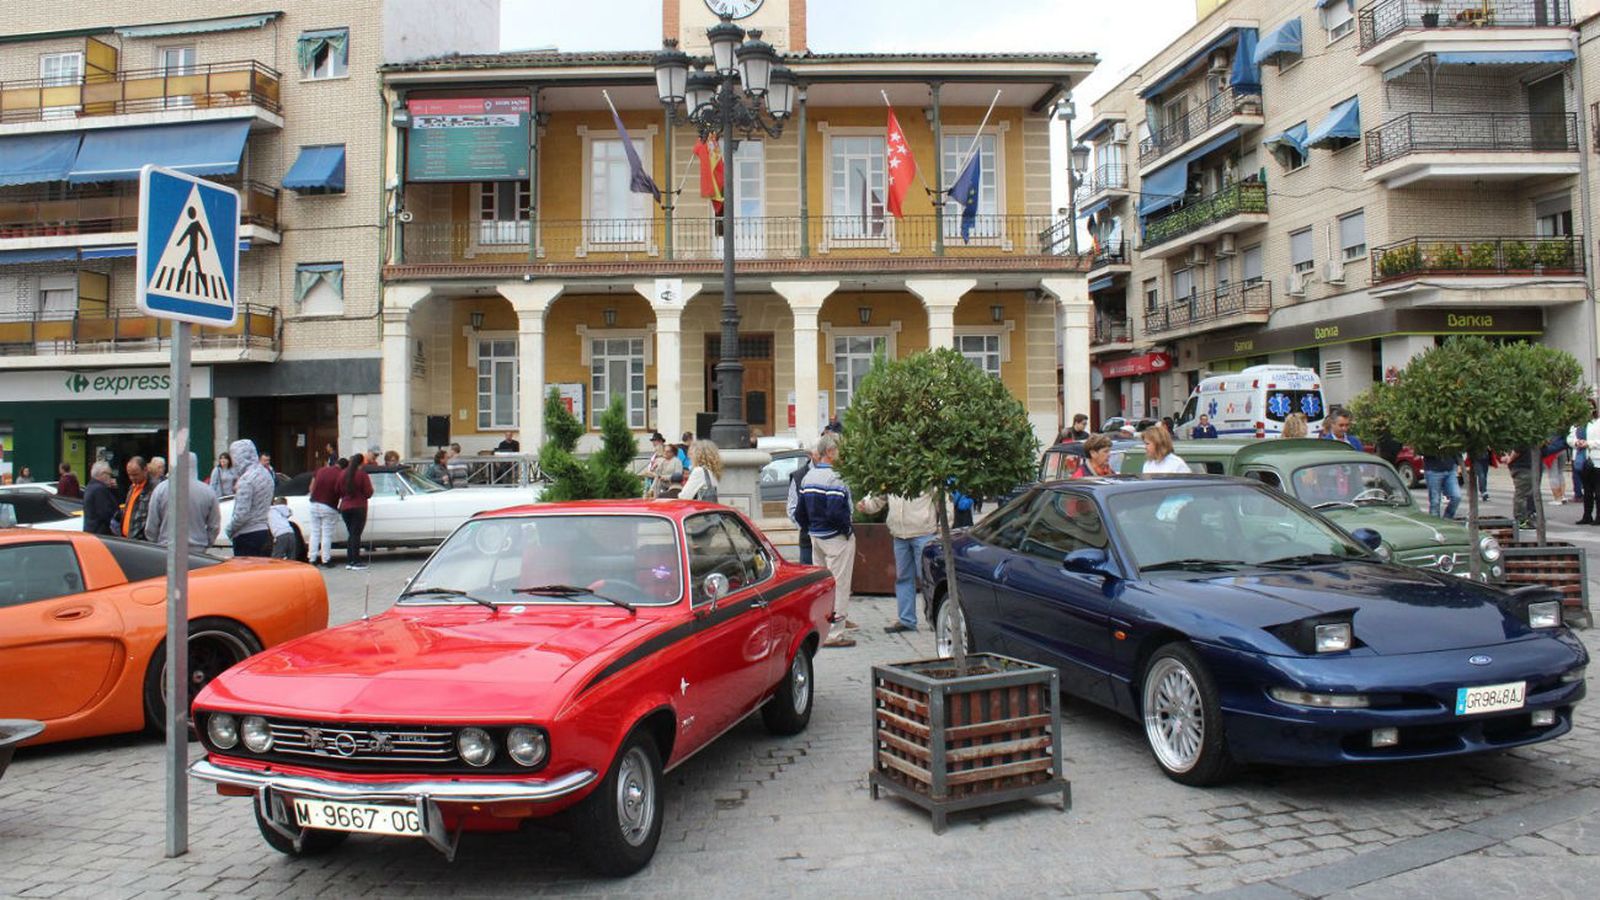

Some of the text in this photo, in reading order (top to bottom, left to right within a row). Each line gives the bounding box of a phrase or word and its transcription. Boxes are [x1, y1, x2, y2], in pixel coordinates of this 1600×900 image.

[1447, 313, 1493, 327] Bankia
[1314, 326, 1339, 339] Bankia
[93, 374, 170, 395] express
[1467, 687, 1525, 708] GR9848AJ
